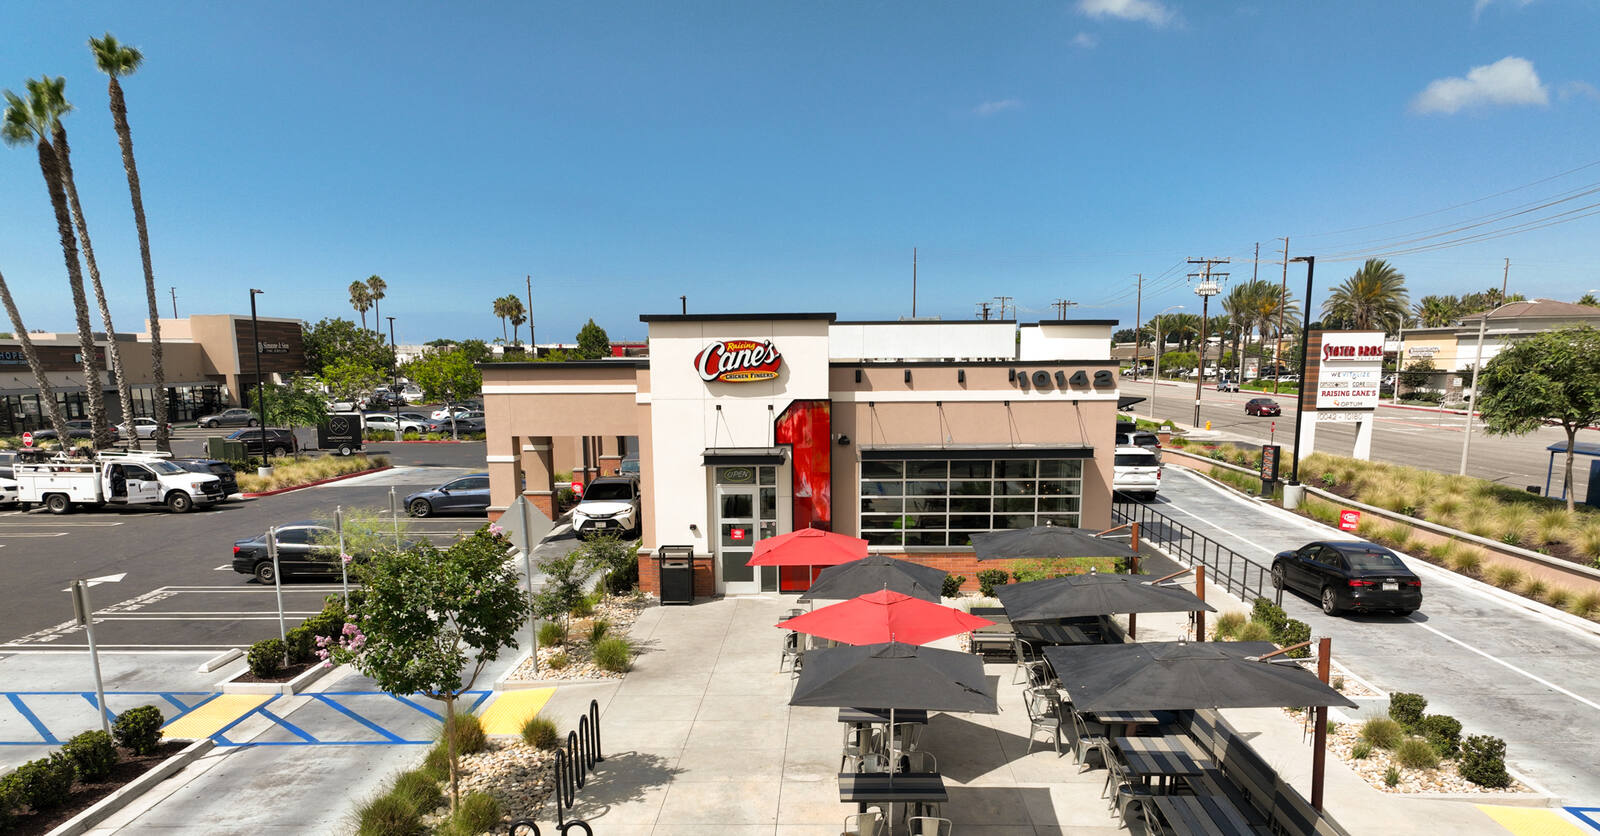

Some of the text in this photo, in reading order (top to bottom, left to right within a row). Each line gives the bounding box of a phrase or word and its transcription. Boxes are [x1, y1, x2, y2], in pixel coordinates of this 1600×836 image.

[726, 341, 756, 351] Raising
[1323, 343, 1356, 361] STATER
[698, 339, 781, 382] Cane's
[1017, 370, 1113, 388] 10142
[726, 470, 748, 478] OPEN
